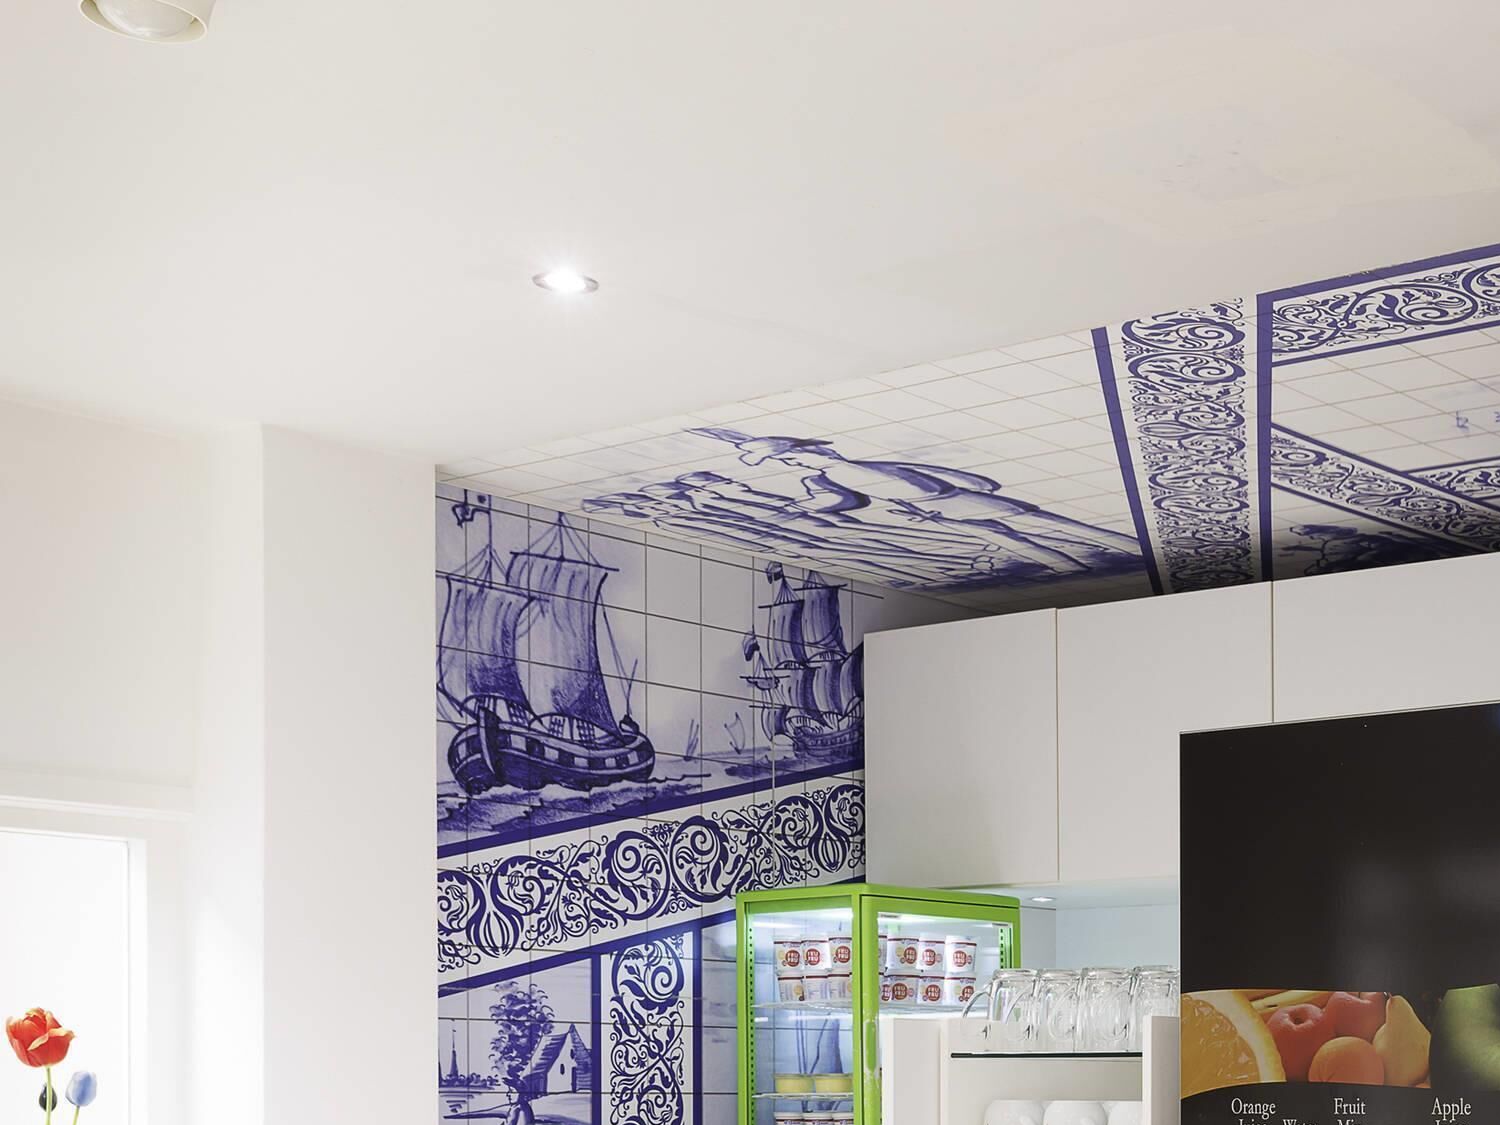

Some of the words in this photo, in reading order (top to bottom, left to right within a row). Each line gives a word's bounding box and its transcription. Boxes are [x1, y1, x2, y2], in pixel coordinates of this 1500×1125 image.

[1231, 1098, 1276, 1119] Orange
[1333, 1098, 1366, 1115] Fruit
[1431, 1097, 1472, 1121] Apple
